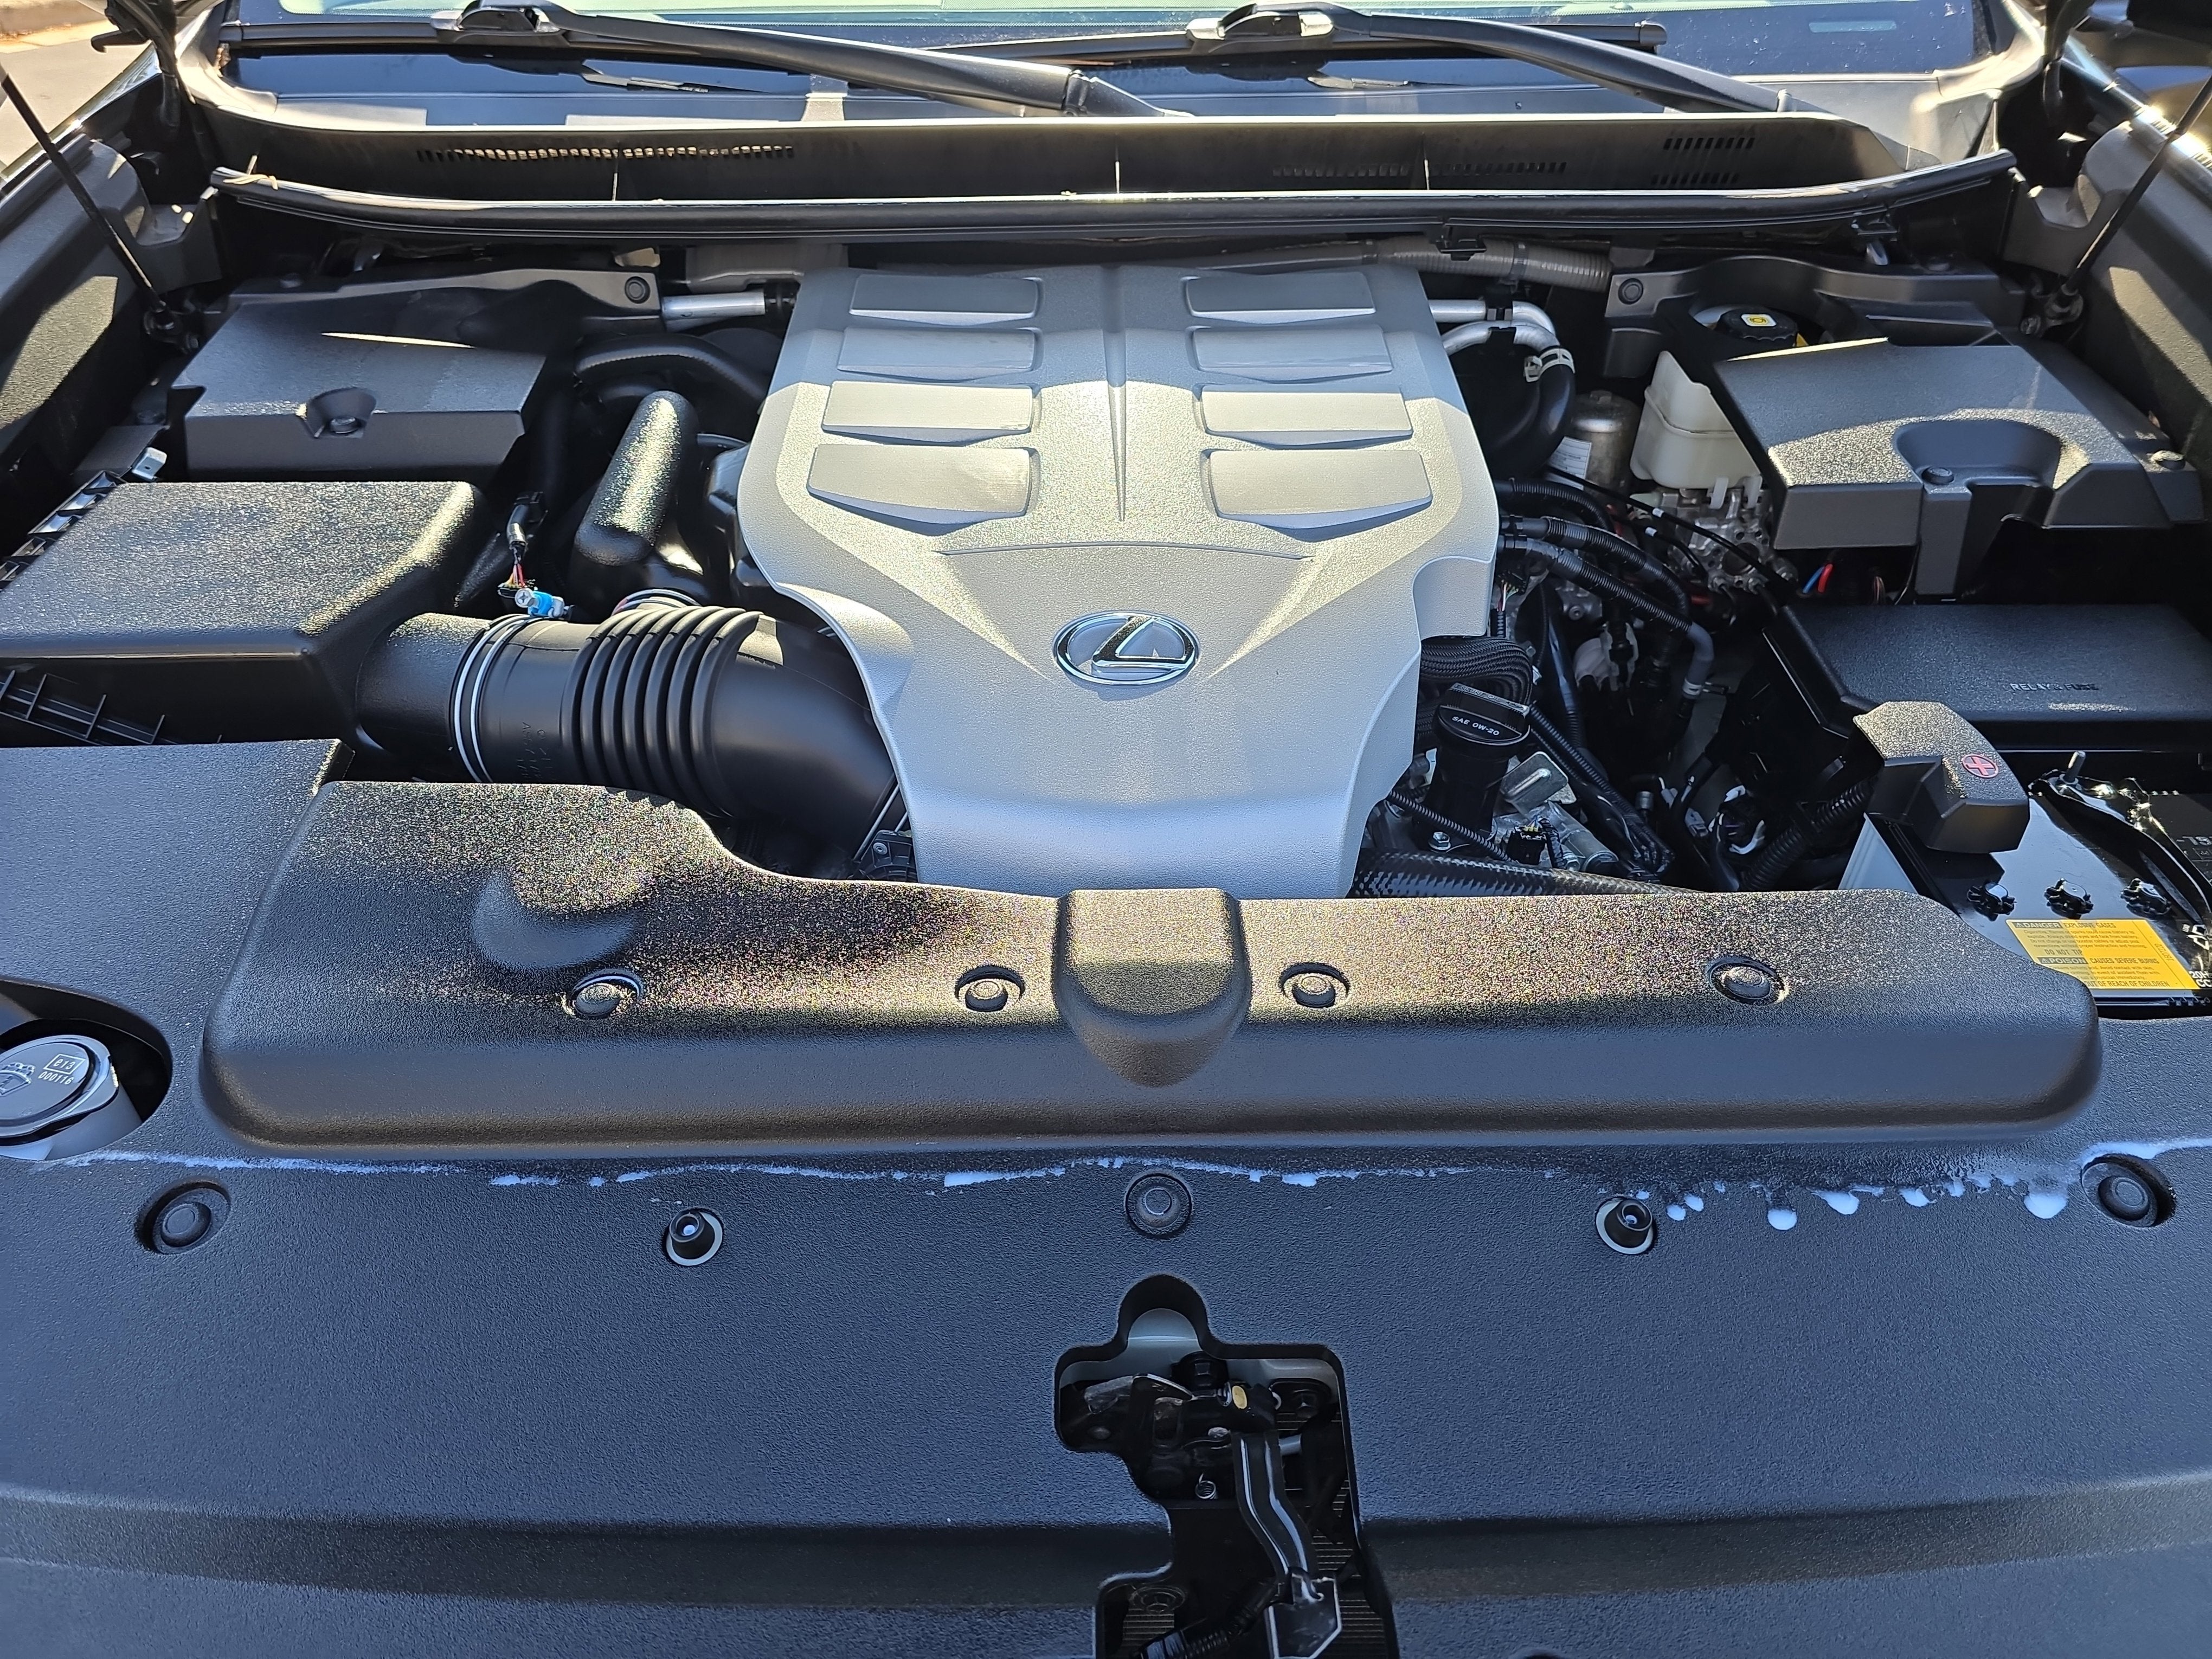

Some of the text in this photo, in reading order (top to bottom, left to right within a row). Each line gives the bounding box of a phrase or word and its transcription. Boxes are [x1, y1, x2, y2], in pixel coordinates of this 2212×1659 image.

[1454, 684, 1501, 702] ENGINE OIL
[2009, 683, 2051, 691] RELAY
[1451, 716, 1500, 736] SAE 0W-20
[53, 1059, 75, 1070] e13
[38, 1071, 74, 1085] 000116
